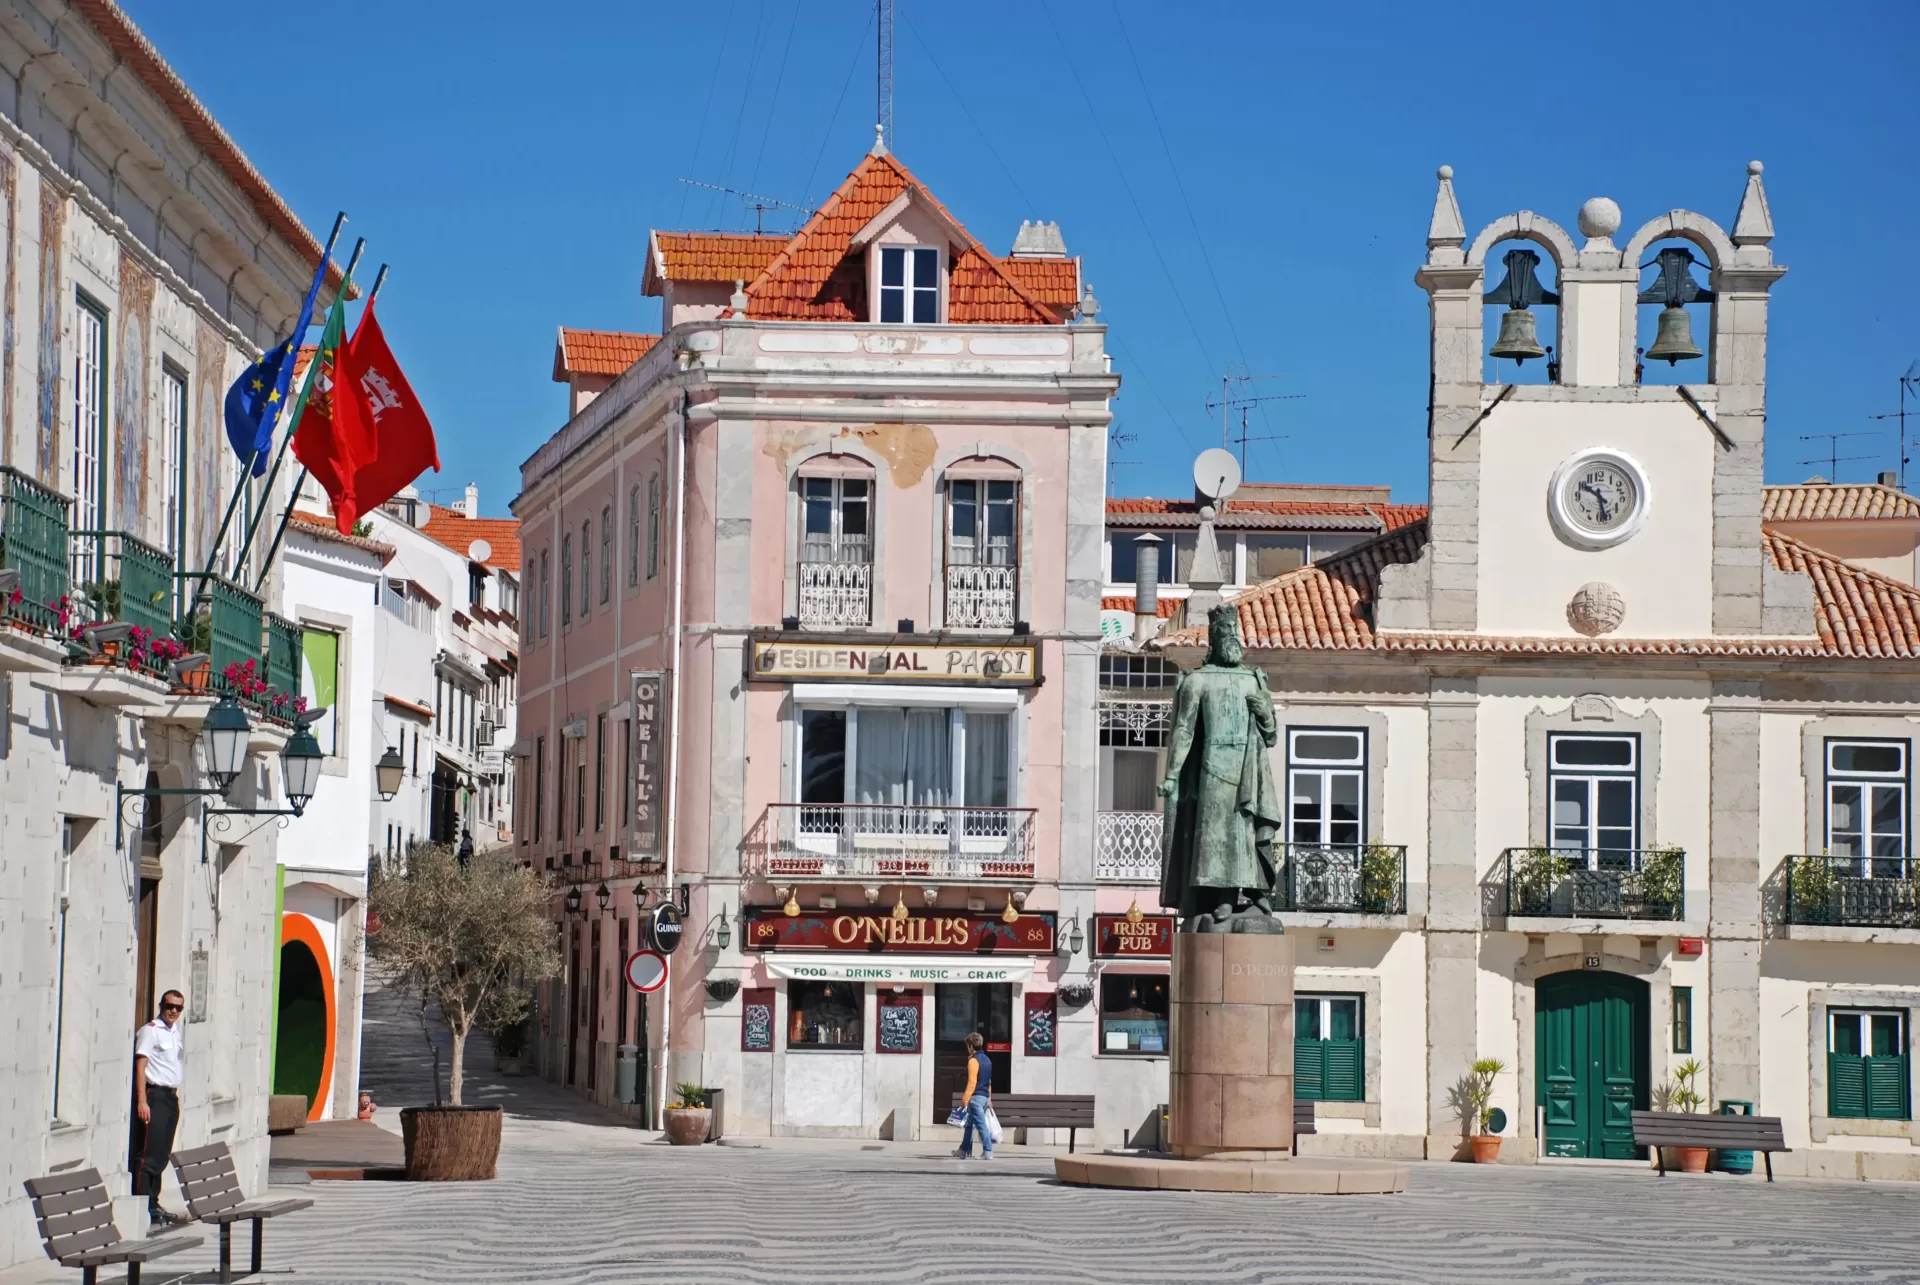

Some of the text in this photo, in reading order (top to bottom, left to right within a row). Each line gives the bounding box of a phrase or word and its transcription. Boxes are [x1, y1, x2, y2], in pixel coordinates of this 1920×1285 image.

[1587, 473, 1593, 483] 11
[1594, 471, 1604, 482] 12
[1609, 475, 1613, 485] 1
[1575, 491, 1581, 502] 9
[1586, 509, 1592, 521] 7
[946, 649, 1027, 675] PARSI
[637, 683, 658, 820] O'NEILL'S
[757, 923, 774, 937] 88
[832, 915, 969, 945] O'NEILL'S
[1027, 928, 1044, 941] 88
[1113, 922, 1158, 936] IRISH
[1119, 936, 1152, 950] PUB
[1587, 958, 1598, 966] 15
[793, 967, 1007, 979] FOOD DRINKS MUSIC CRAIC
[1247, 963, 1288, 977] PEDRO
